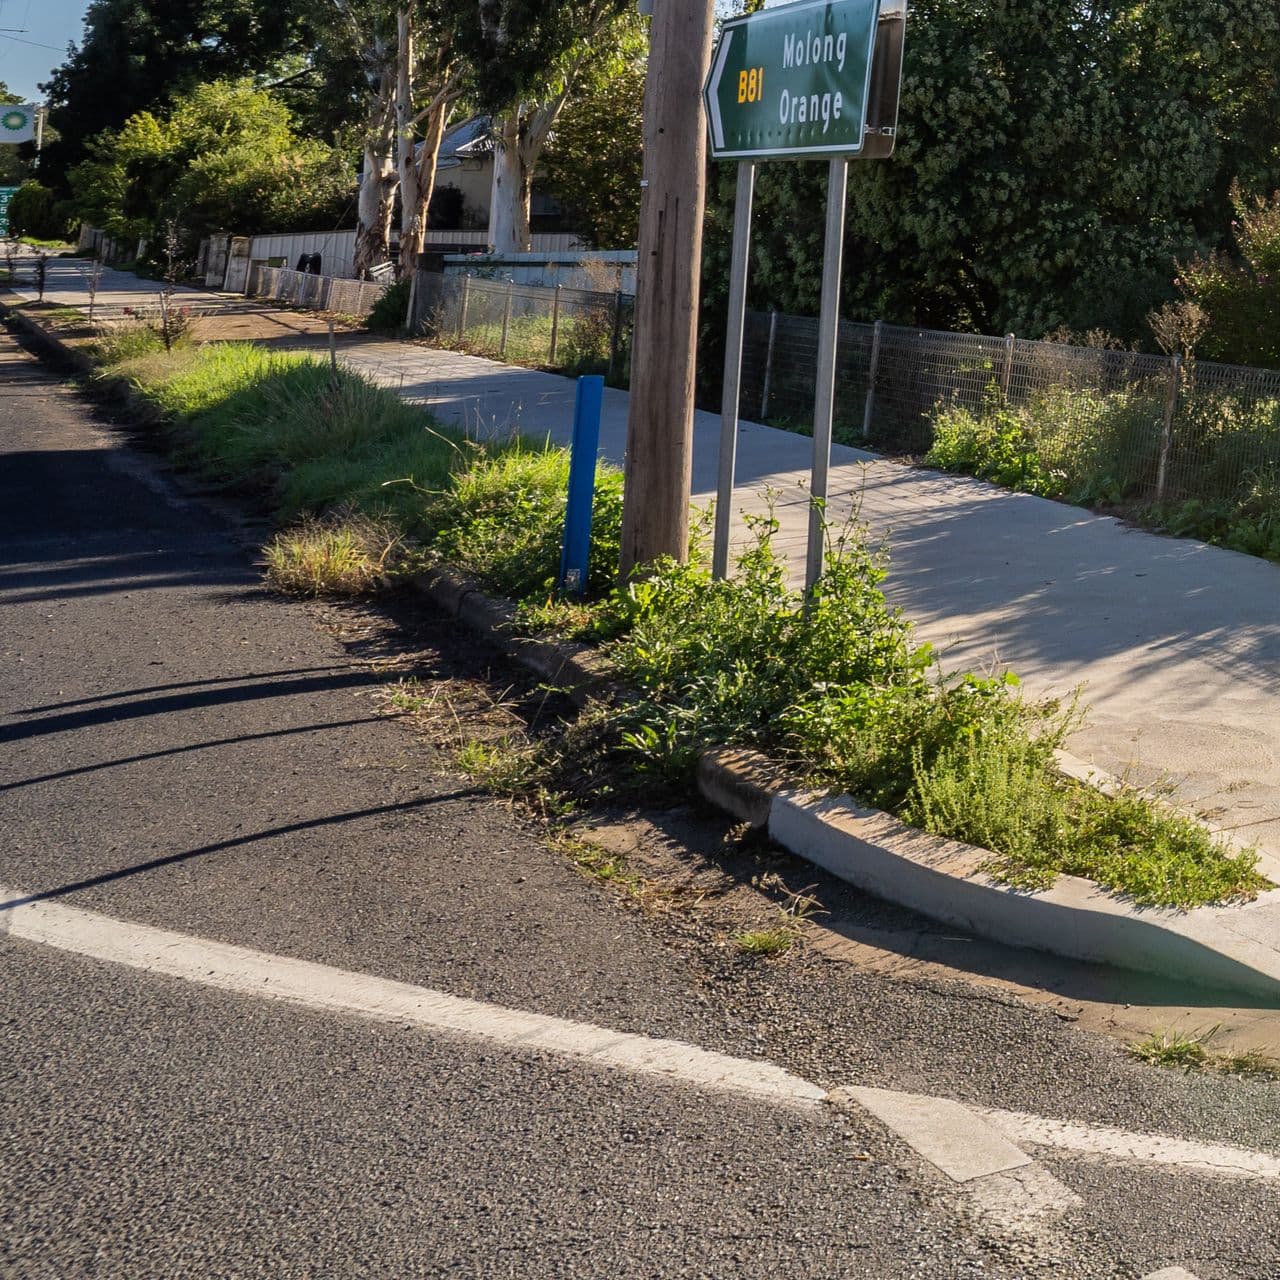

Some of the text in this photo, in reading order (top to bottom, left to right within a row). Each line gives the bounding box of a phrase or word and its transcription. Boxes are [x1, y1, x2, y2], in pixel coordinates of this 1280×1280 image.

[782, 30, 848, 72] Molong
[737, 67, 764, 104] B81
[779, 88, 843, 132] Orange
